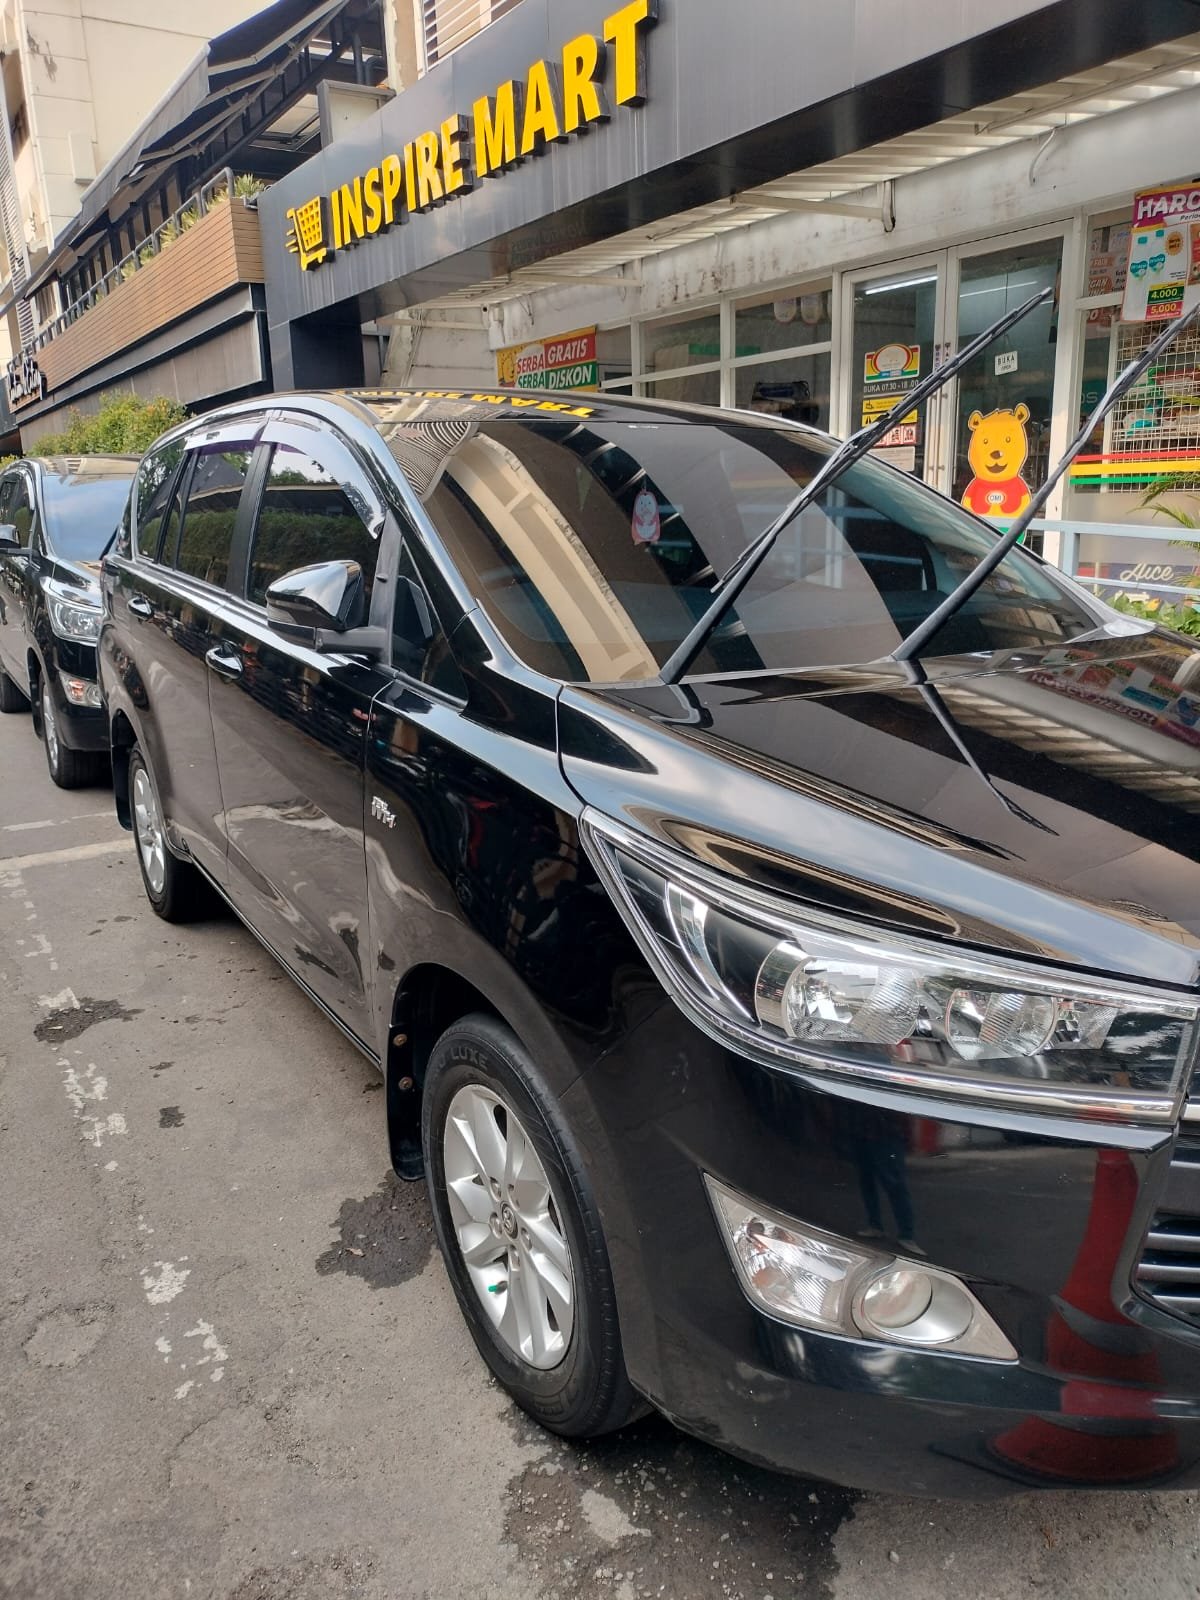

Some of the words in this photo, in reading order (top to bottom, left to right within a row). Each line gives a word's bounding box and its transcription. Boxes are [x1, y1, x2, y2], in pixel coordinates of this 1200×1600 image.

[331, 113, 467, 250] INSPIRE
[473, 0, 652, 178] MART
[1151, 288, 1178, 299] 4.000
[1151, 303, 1177, 314] 5.000
[516, 353, 545, 374] SERBA
[547, 338, 588, 365] GRATIS
[517, 371, 545, 389] SERBA
[549, 364, 593, 389] DISKON
[863, 384, 881, 393] BUKA
[450, 1046, 488, 1071] LUXE
